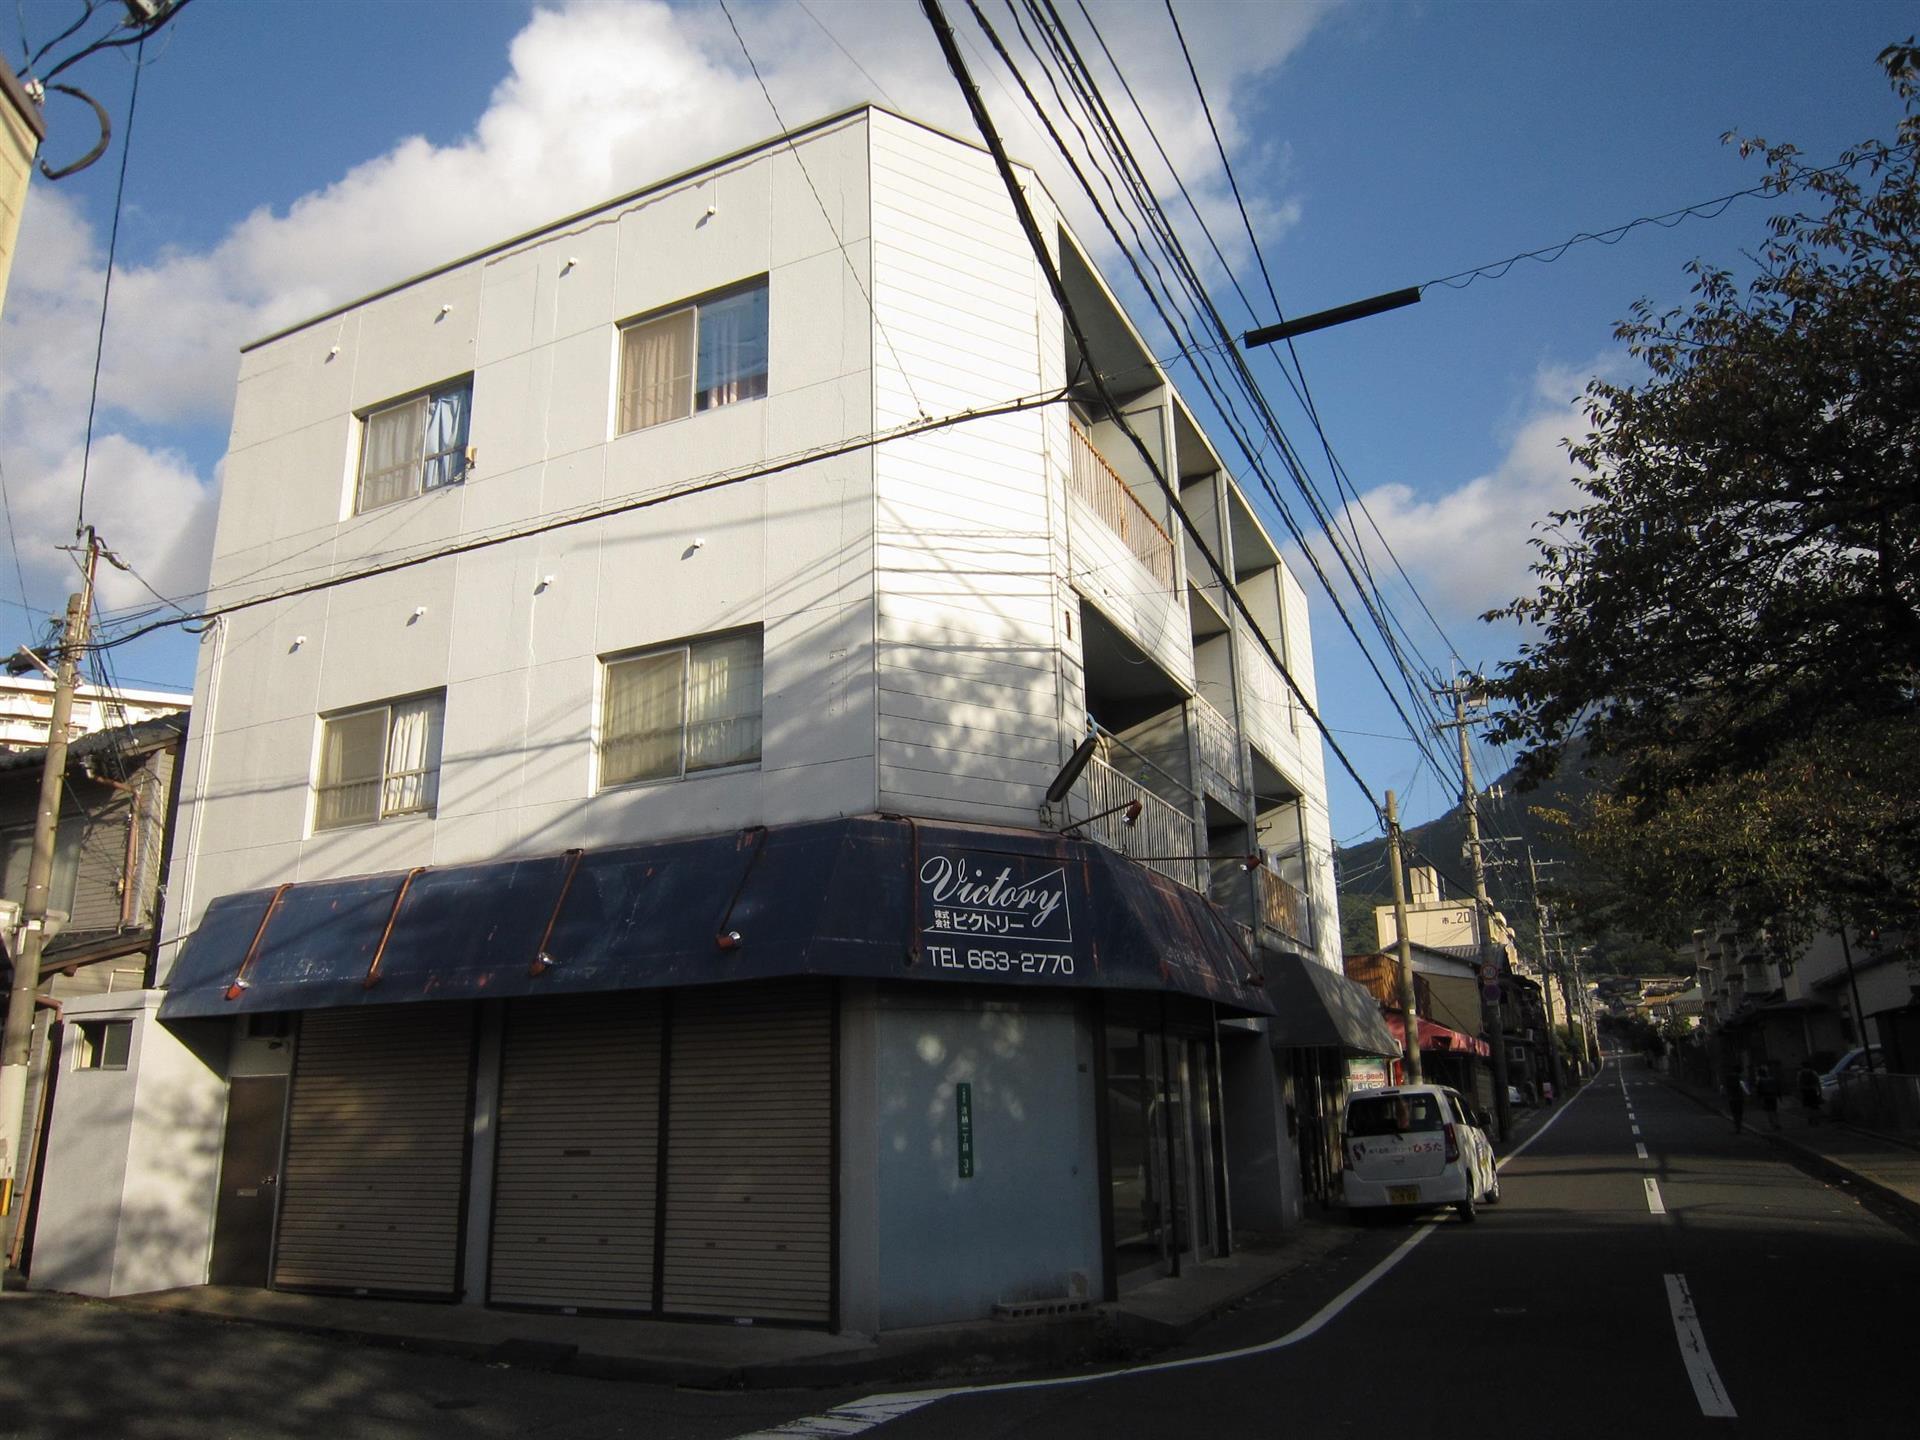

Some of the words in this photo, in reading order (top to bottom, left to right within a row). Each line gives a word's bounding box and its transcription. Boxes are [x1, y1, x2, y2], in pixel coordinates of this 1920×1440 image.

[920, 855, 1063, 928] Victory
[953, 912, 1024, 933] ビクトリー
[927, 946, 964, 969] TEL
[967, 949, 1075, 975] 663-2770
